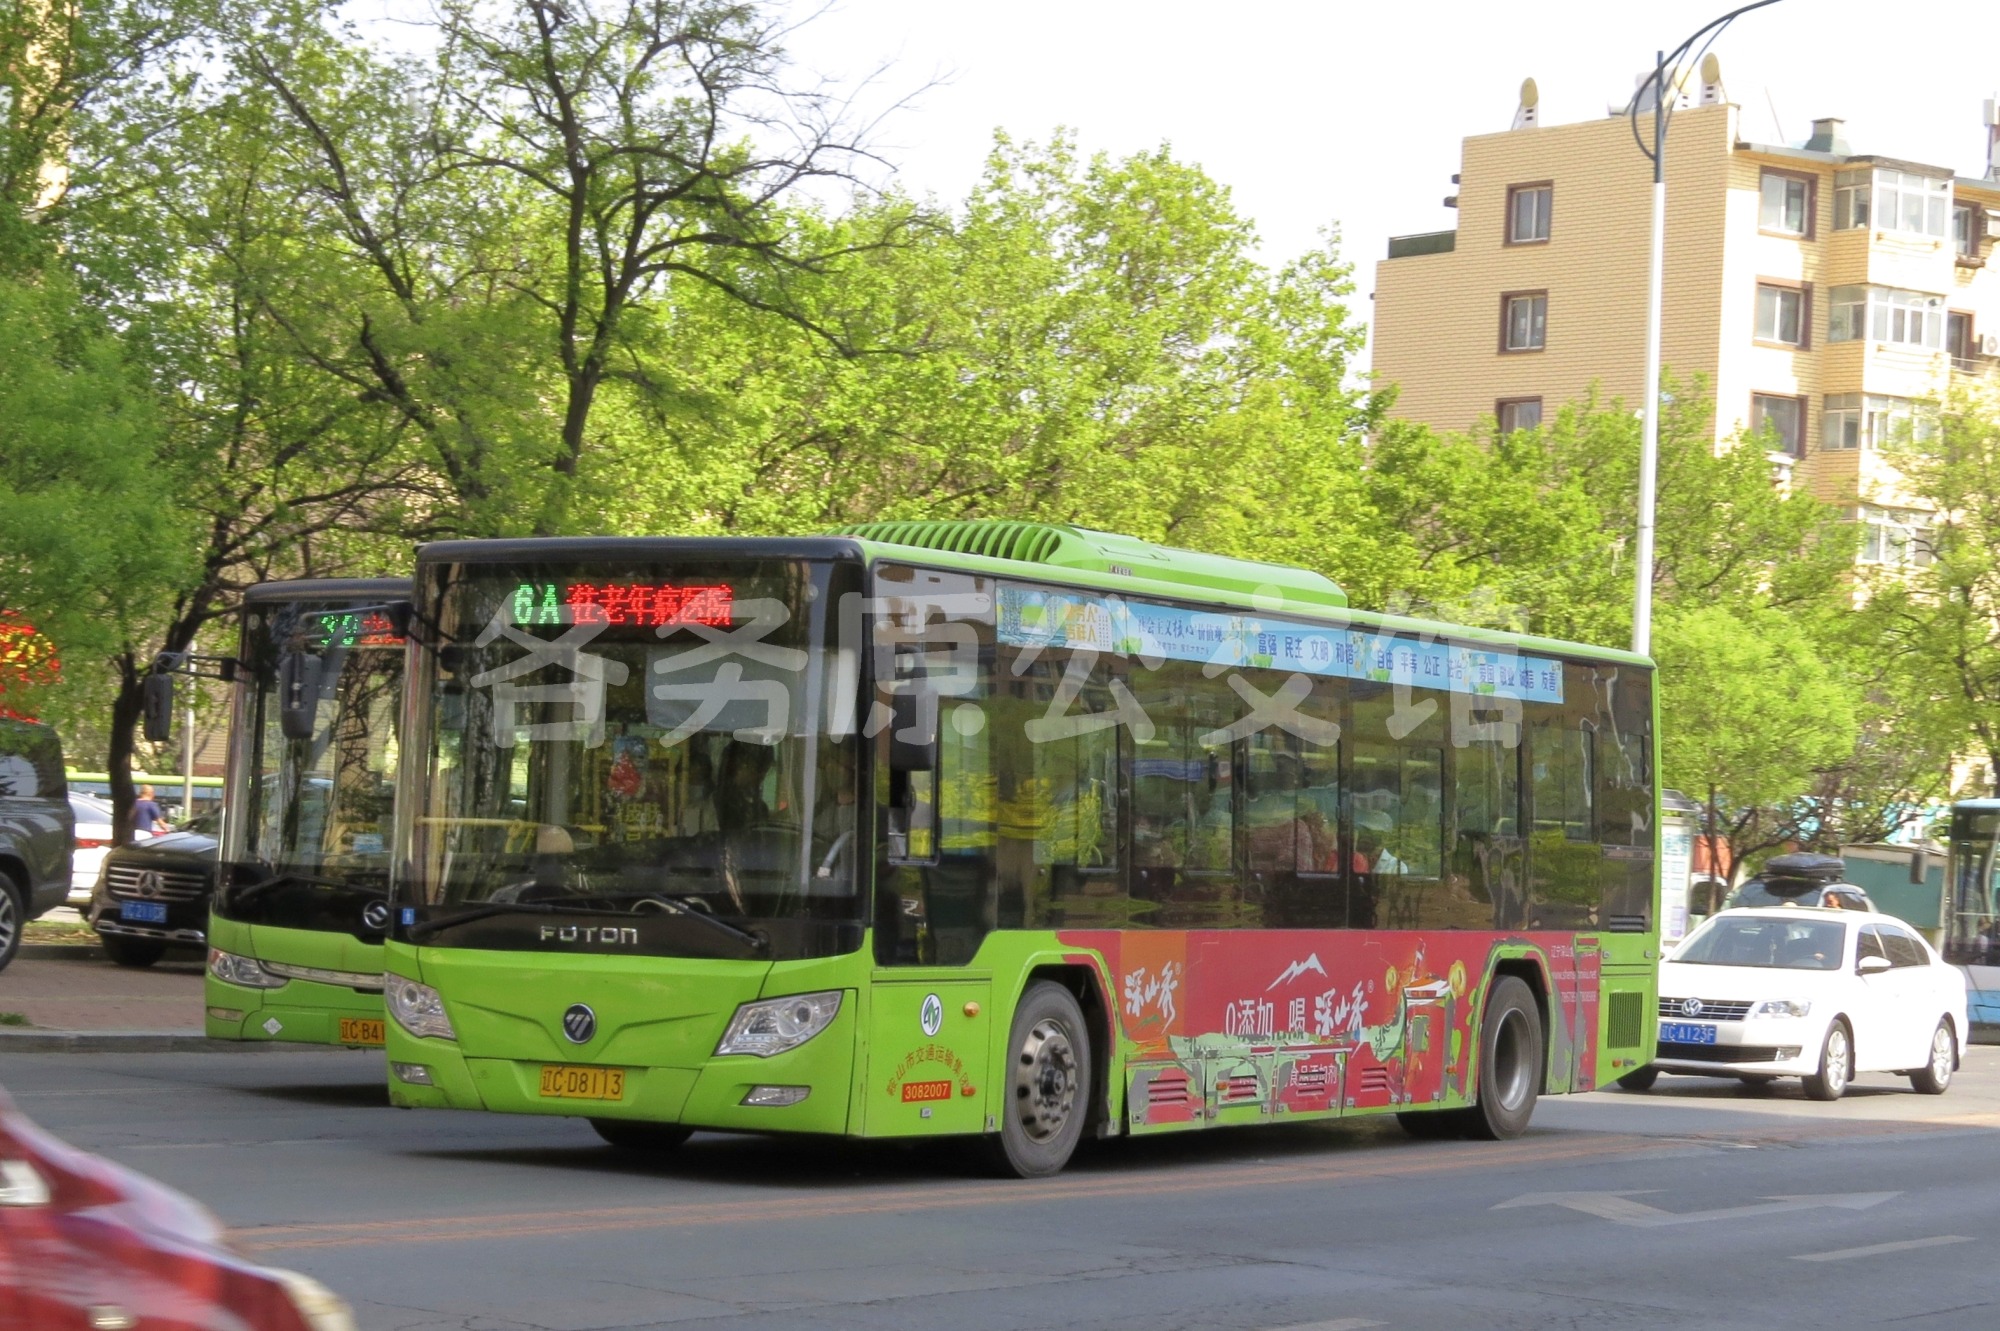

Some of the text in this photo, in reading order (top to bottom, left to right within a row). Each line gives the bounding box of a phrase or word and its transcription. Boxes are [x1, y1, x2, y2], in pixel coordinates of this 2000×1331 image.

[514, 584, 560, 624] 6A
[1257, 632, 1354, 665] 富强 民主 文明 和谐
[1377, 649, 1463, 680] 自由 平等 公正 法治
[1479, 663, 1495, 685] 爱国
[1500, 665, 1515, 687] 敬业
[1541, 671, 1556, 692] 友善
[541, 925, 638, 944] FOTON
[904, 1083, 949, 1100] 3082007
